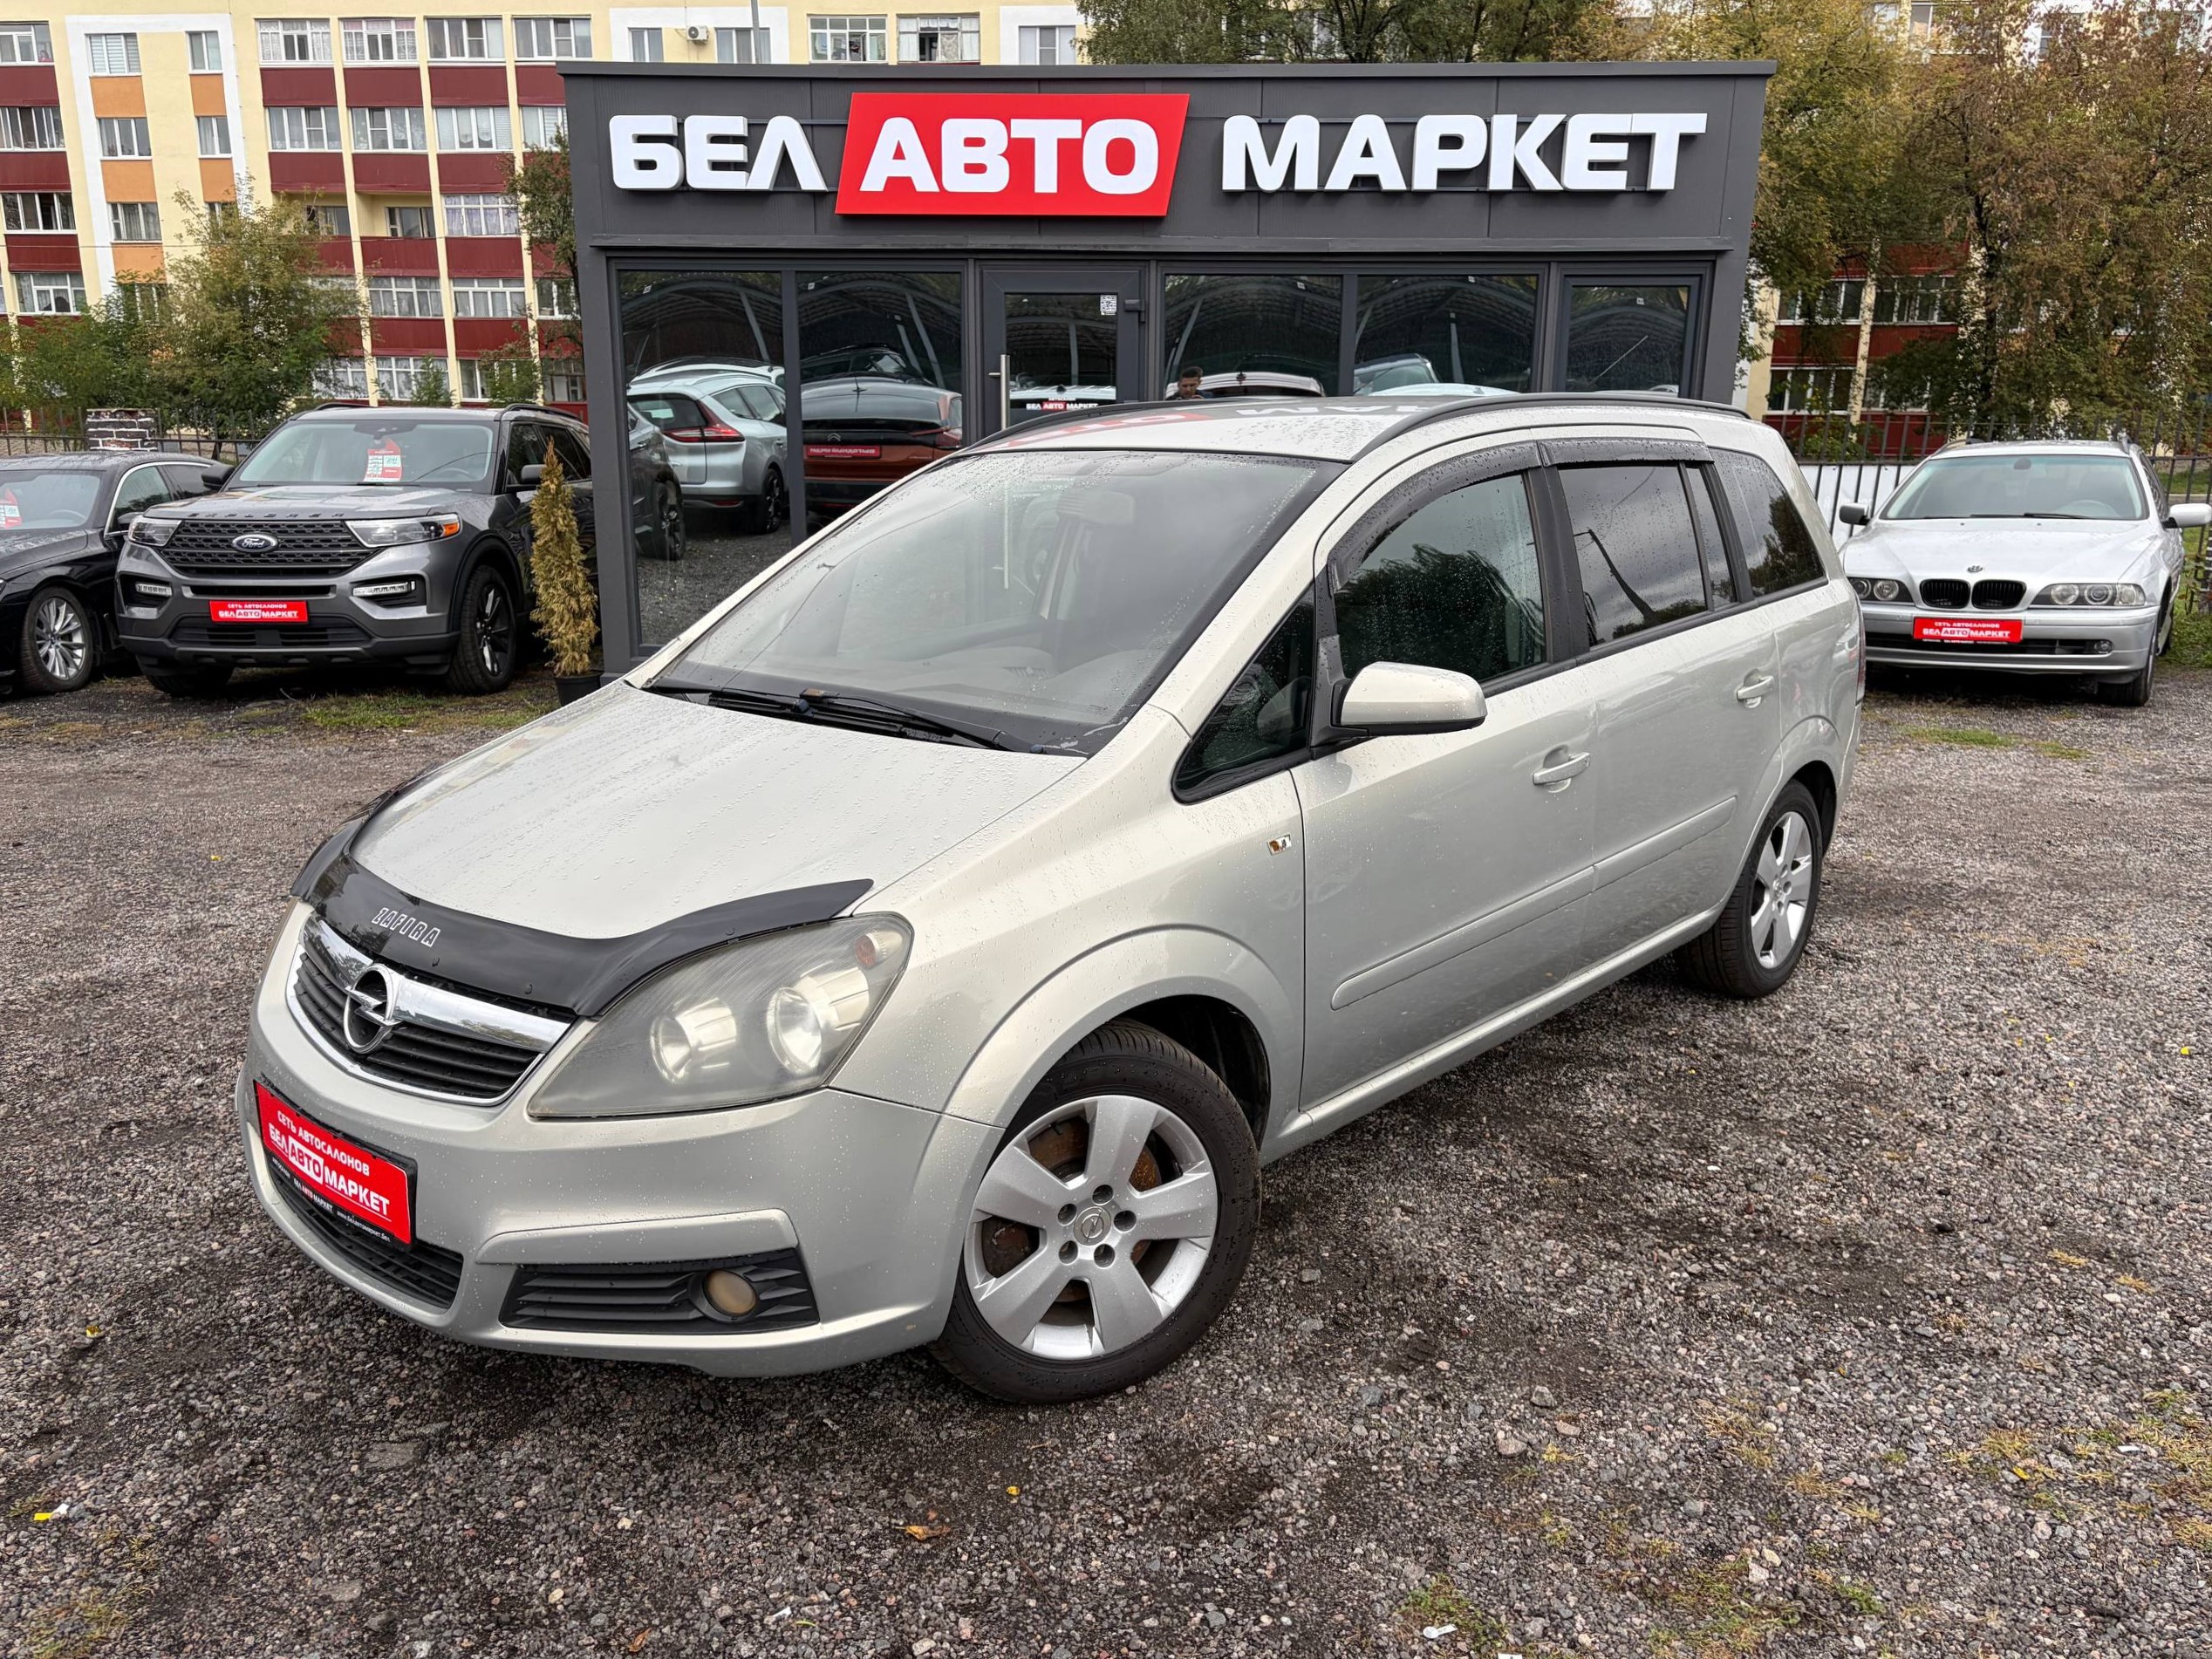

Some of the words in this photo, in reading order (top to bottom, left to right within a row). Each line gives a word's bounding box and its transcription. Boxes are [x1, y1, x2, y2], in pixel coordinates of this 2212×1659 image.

[610, 115, 829, 191] БЕЛ
[859, 116, 1159, 195] АВТО
[1221, 113, 1708, 193] МАРКЕТ
[242, 537, 265, 548] Ford
[1970, 629, 2011, 638] МАРКЕТ
[372, 907, 441, 947] ZAFIRA
[277, 1109, 297, 1134] СЕТЬ
[298, 1126, 370, 1177] АВТОСАЛОНОВ
[269, 1122, 290, 1154] БЕЛ
[290, 1144, 323, 1179] АВТО
[324, 1166, 390, 1216] МАРКЕТ
[314, 1194, 334, 1212] МАРКЕТ
